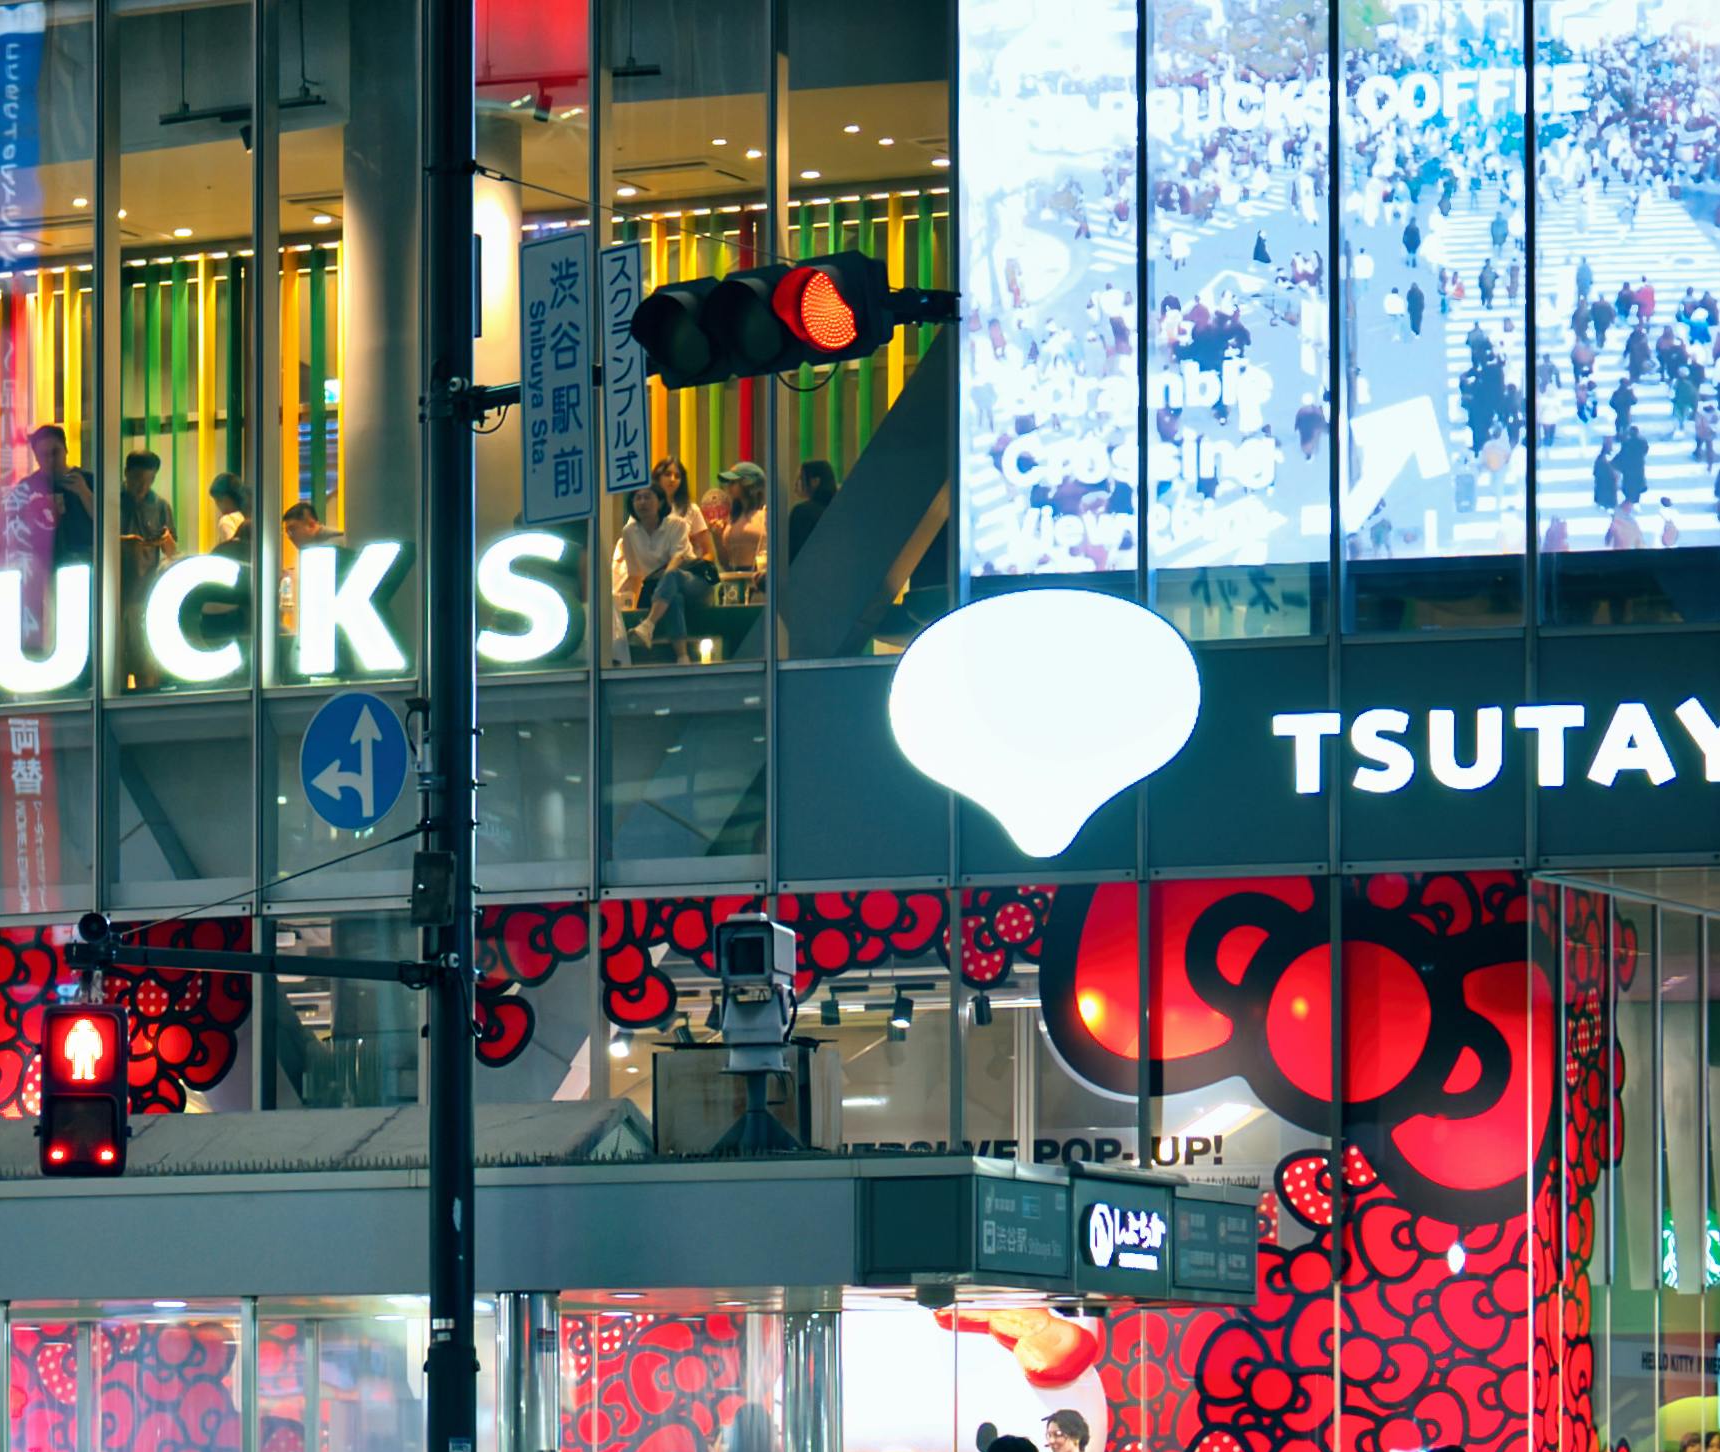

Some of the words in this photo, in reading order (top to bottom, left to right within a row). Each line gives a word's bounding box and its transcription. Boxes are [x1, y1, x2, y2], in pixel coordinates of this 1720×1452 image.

[1356, 62, 1591, 127] COFFEE
[528, 299, 547, 410] Shibuya
[549, 256, 583, 500] 渋谷駅前
[610, 254, 640, 483] スクランブル式
[531, 420, 548, 475] Sta.
[1671, 1353, 1695, 1374] KITTY
